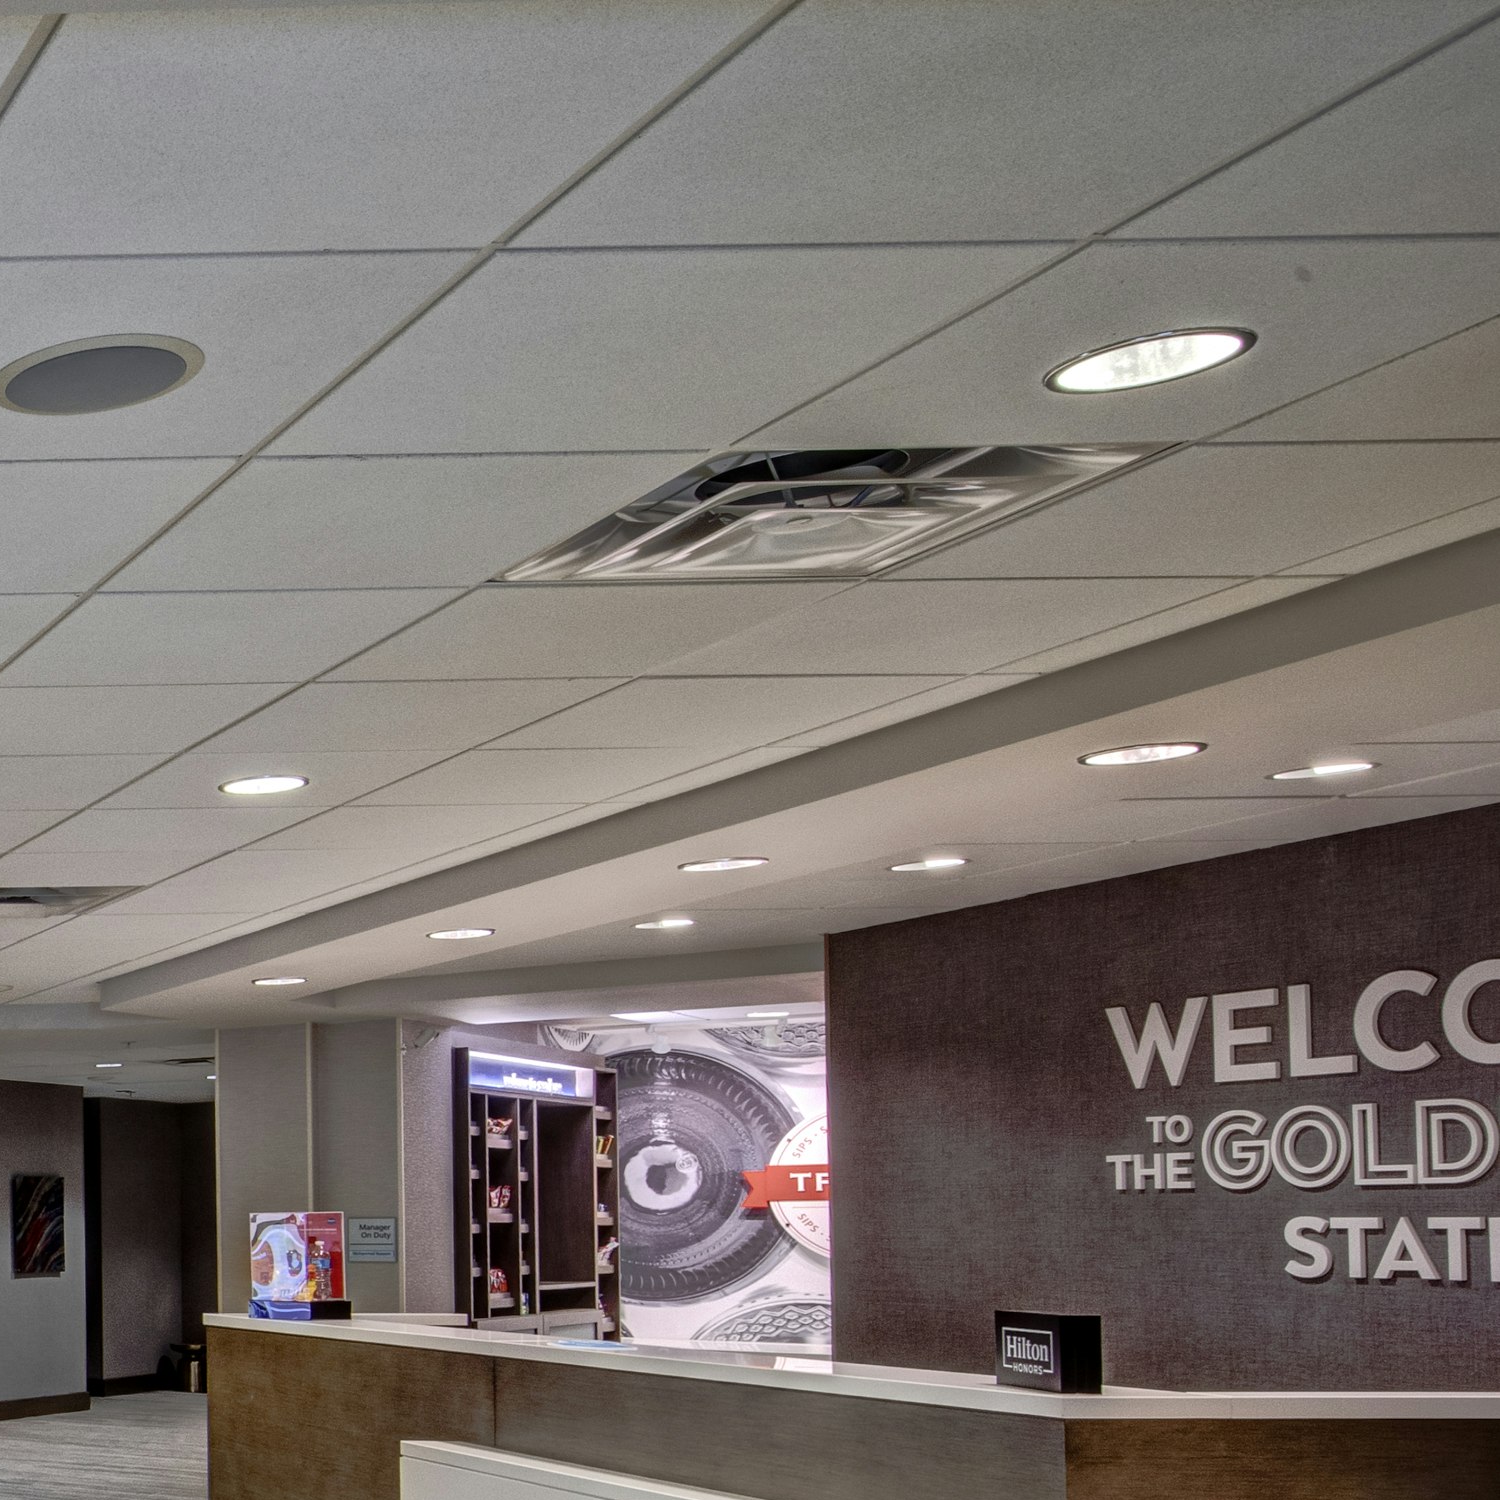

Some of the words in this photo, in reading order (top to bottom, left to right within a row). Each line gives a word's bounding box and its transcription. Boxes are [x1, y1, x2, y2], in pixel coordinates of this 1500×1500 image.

[1105, 959, 1500, 1089] WELCO
[1146, 1114, 1194, 1143] TO
[791, 1137, 812, 1158] SIPS
[1106, 1151, 1195, 1190] THE
[1201, 1099, 1500, 1190] GOLD
[796, 1212, 820, 1233] SIPS
[373, 1231, 391, 1240] Duty
[1006, 1335, 1049, 1362] Hilton
[1012, 1362, 1043, 1375] HONORS
